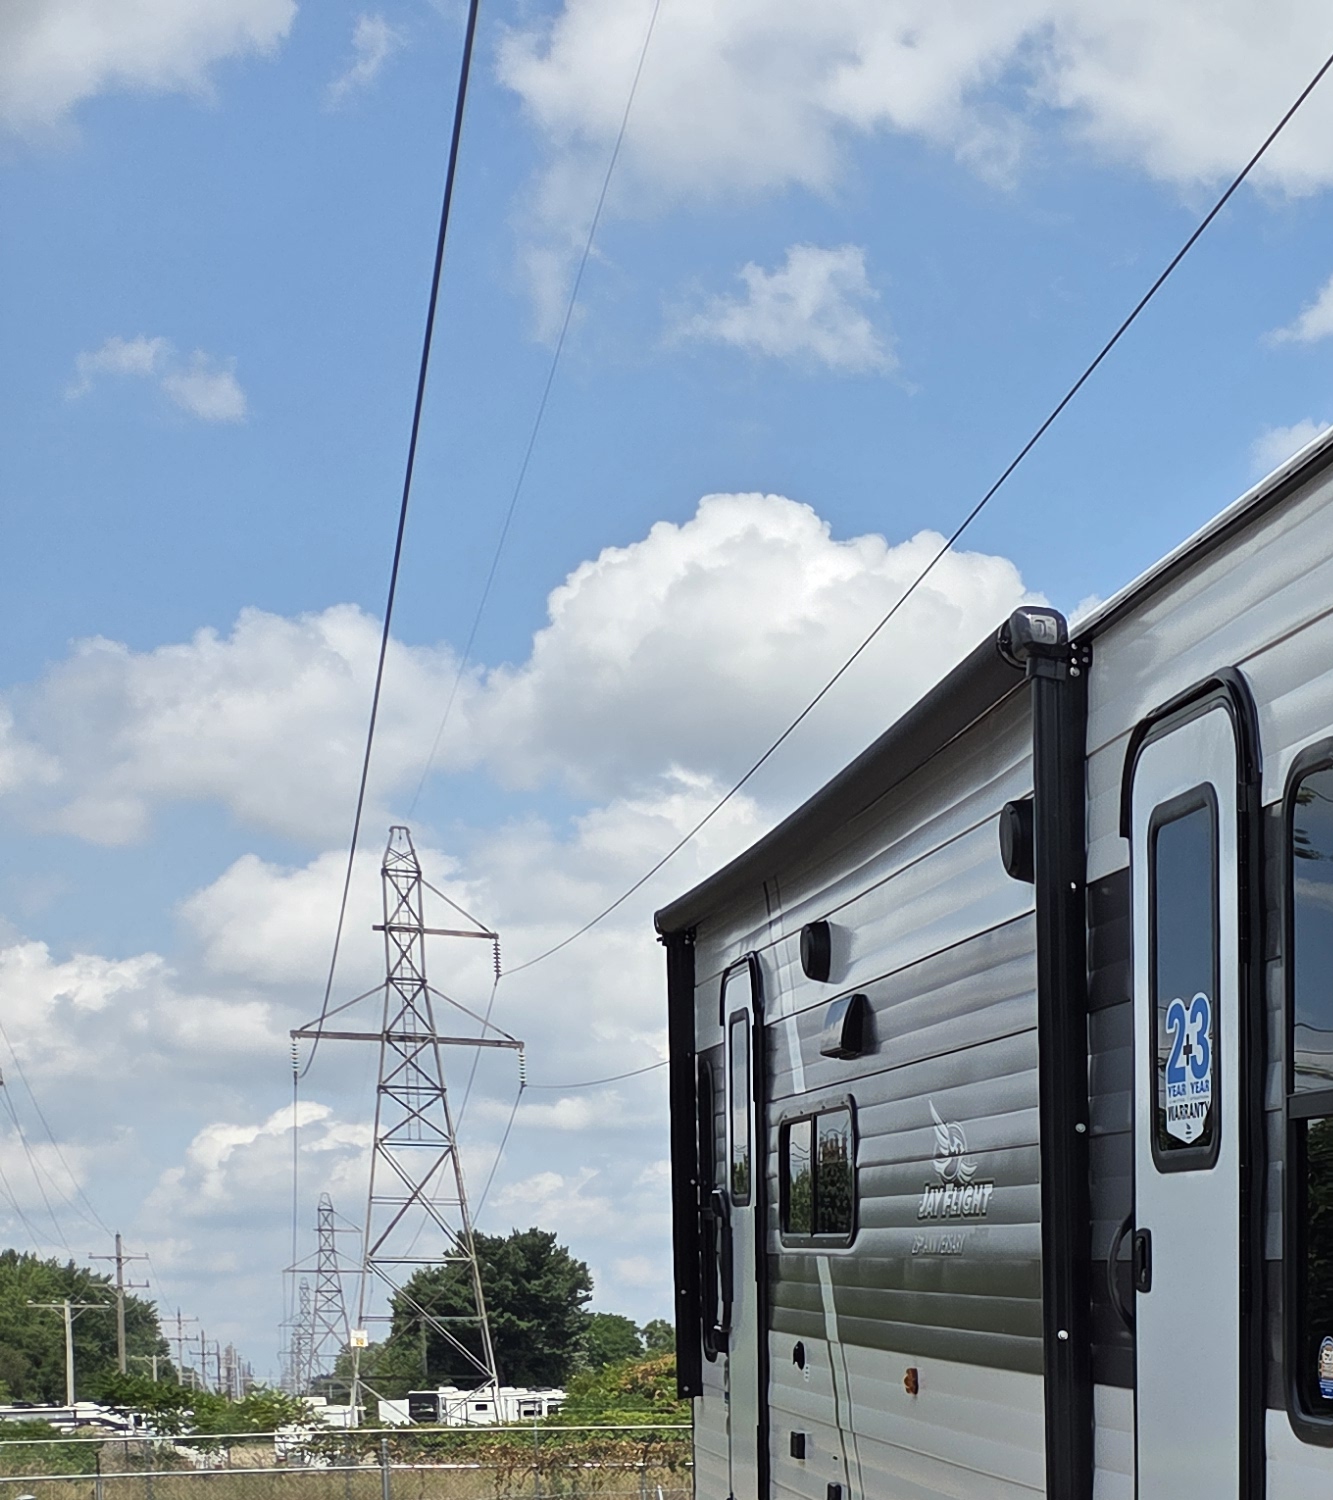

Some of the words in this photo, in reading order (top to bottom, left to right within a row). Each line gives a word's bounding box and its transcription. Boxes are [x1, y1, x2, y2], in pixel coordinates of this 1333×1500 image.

[1168, 1084, 1187, 1099] YEAR
[1190, 1080, 1210, 1095] YEAR
[1168, 1101, 1210, 1122] WARRANTY
[918, 1184, 944, 1219] JAY
[941, 1182, 994, 1219] FLIGHT
